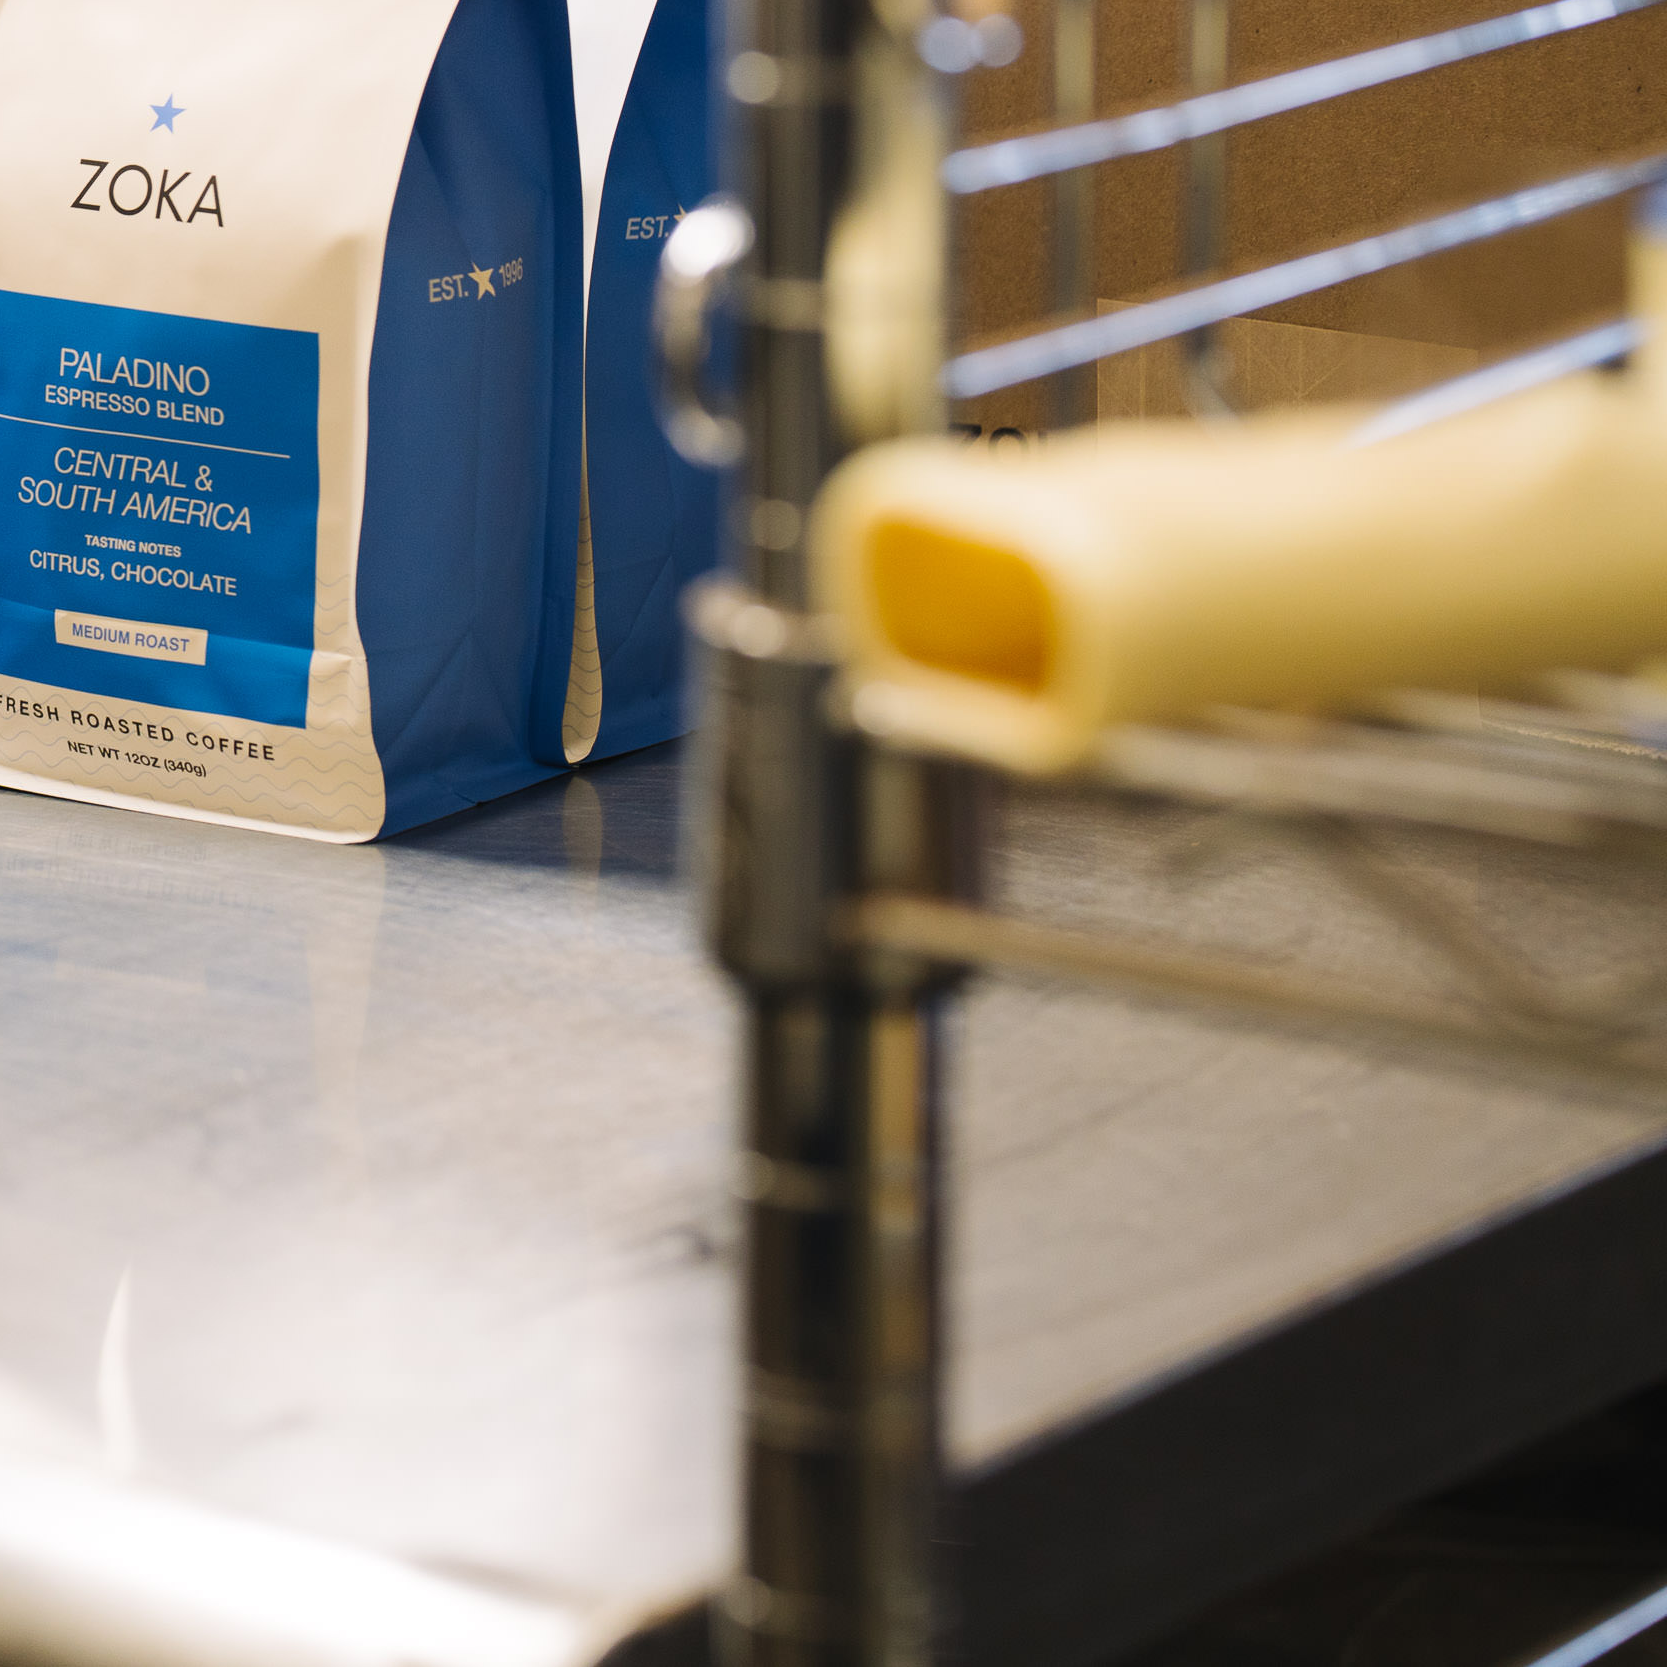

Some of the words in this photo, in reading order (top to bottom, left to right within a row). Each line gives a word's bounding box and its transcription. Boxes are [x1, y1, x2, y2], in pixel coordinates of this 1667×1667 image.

[70, 158, 224, 228] ZOKA
[625, 215, 669, 240] EST.
[428, 274, 469, 303] EST.
[498, 256, 524, 288] 1996
[59, 347, 210, 397] PALADINO
[45, 384, 150, 416] ESPRESSO
[156, 400, 225, 426] BLEND
[54, 446, 187, 489] CENTRAL
[194, 465, 213, 493] &
[18, 476, 117, 515] SOUTH
[121, 492, 252, 534] AMERICA
[85, 534, 136, 552] TASTING
[138, 541, 182, 558] NOTES
[29, 549, 105, 581] CITRUS,
[110, 562, 237, 597] CHOCOLATE
[72, 622, 131, 646] MEDIUM
[134, 630, 190, 653] ROAST
[67, 740, 94, 755] NET
[98, 746, 120, 761] WT
[124, 752, 161, 769] 12OZ
[164, 758, 207, 778] (340g)
[71, 710, 174, 742] ROASTED
[186, 732, 274, 761] COFFEE
